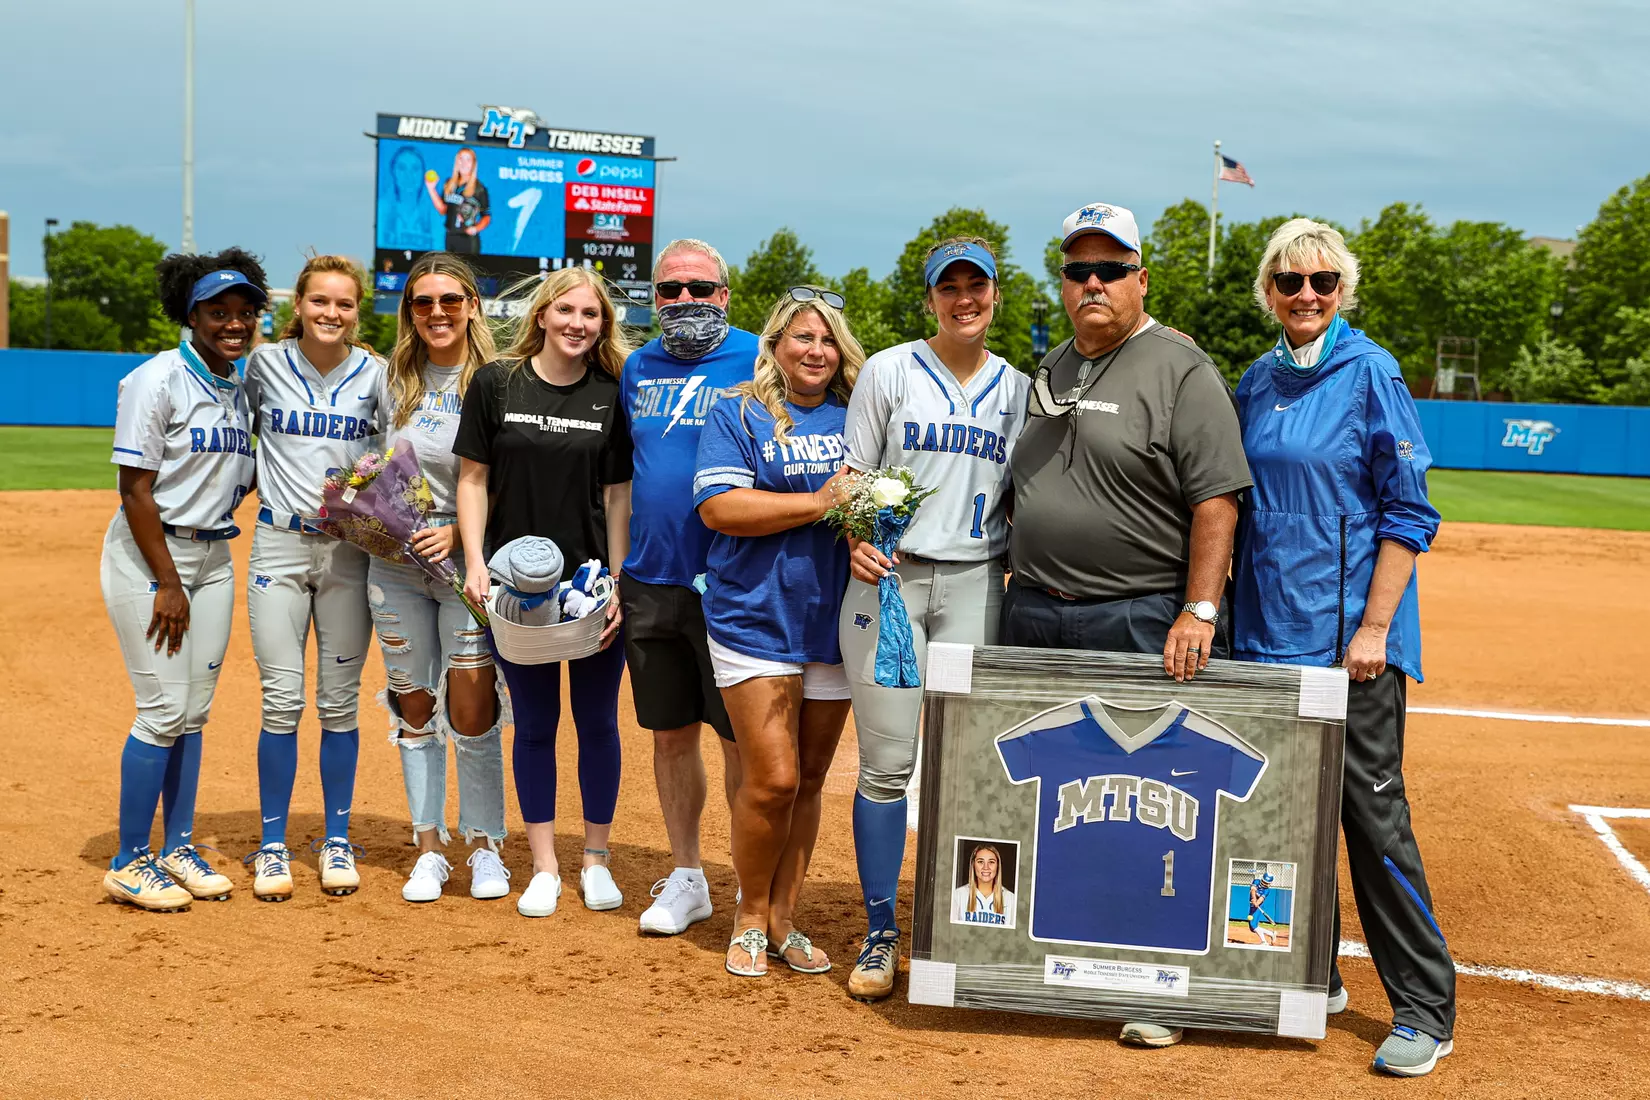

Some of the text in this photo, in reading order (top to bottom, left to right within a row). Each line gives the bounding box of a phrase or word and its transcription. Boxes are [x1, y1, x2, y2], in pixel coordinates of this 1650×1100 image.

[397, 116, 468, 141] MIDDLE
[548, 130, 645, 155] TENNESSEE
[517, 156, 564, 169] SUMMER
[498, 166, 564, 183] BURGESS
[600, 165, 643, 181] pepsi
[571, 184, 647, 202] DEB INSELL
[583, 243, 636, 258] 10:37 AM
[632, 385, 680, 420] BOLT
[271, 408, 369, 441] RAIDERS
[504, 412, 603, 432] MIDDLE TENNESSEE
[539, 424, 568, 434] SOFTBALL
[902, 421, 1007, 465] RAIDERS
[1502, 420, 1555, 456] MT
[784, 463, 805, 477] OUR
[969, 492, 987, 539] 1
[1053, 773, 1200, 843] MTSU
[1160, 849, 1176, 897] 1
[964, 910, 1006, 925] RAIDERS
[1092, 963, 1143, 974] SUMMER BURGESS
